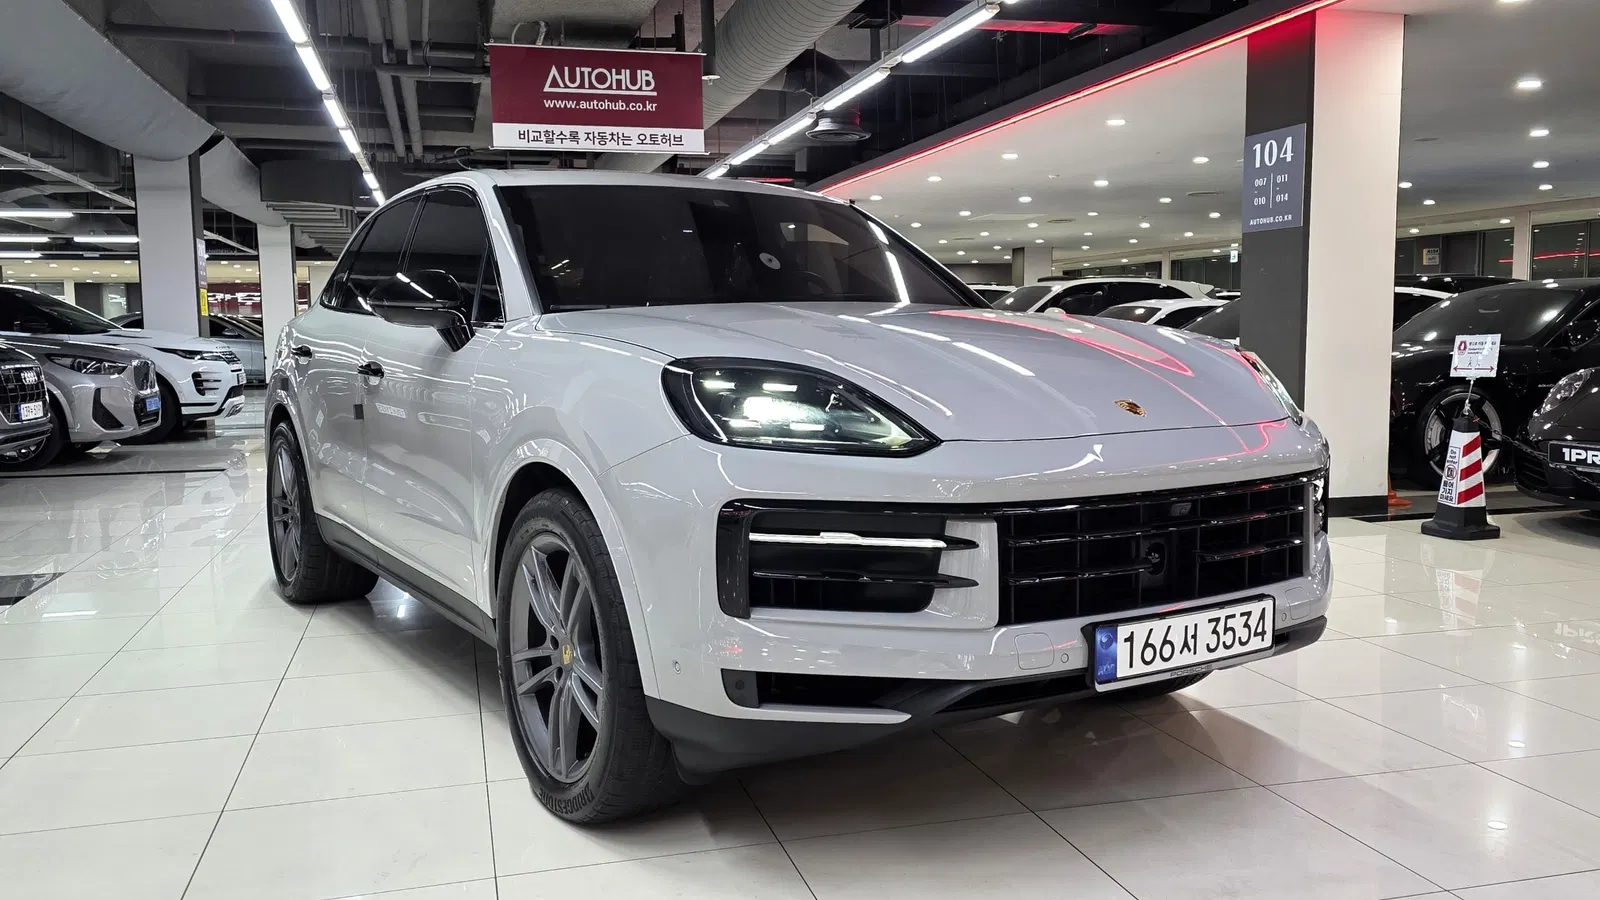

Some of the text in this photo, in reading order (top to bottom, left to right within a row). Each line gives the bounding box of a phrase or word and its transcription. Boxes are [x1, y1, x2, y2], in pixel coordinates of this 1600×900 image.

[543, 65, 657, 96] AUTOHUB
[543, 98, 658, 112] www.autohub.co.kr
[518, 129, 685, 147] 비교할수록 자동차는 오토허브
[1252, 136, 1294, 169] 104
[1254, 177, 1267, 187] 007
[1276, 174, 1288, 183] 011
[1253, 196, 1266, 206] 010
[1275, 193, 1289, 203] 014
[1249, 214, 1293, 226] AUTOHUB.CO.KR
[1123, 606, 1267, 669] 166서 3534
